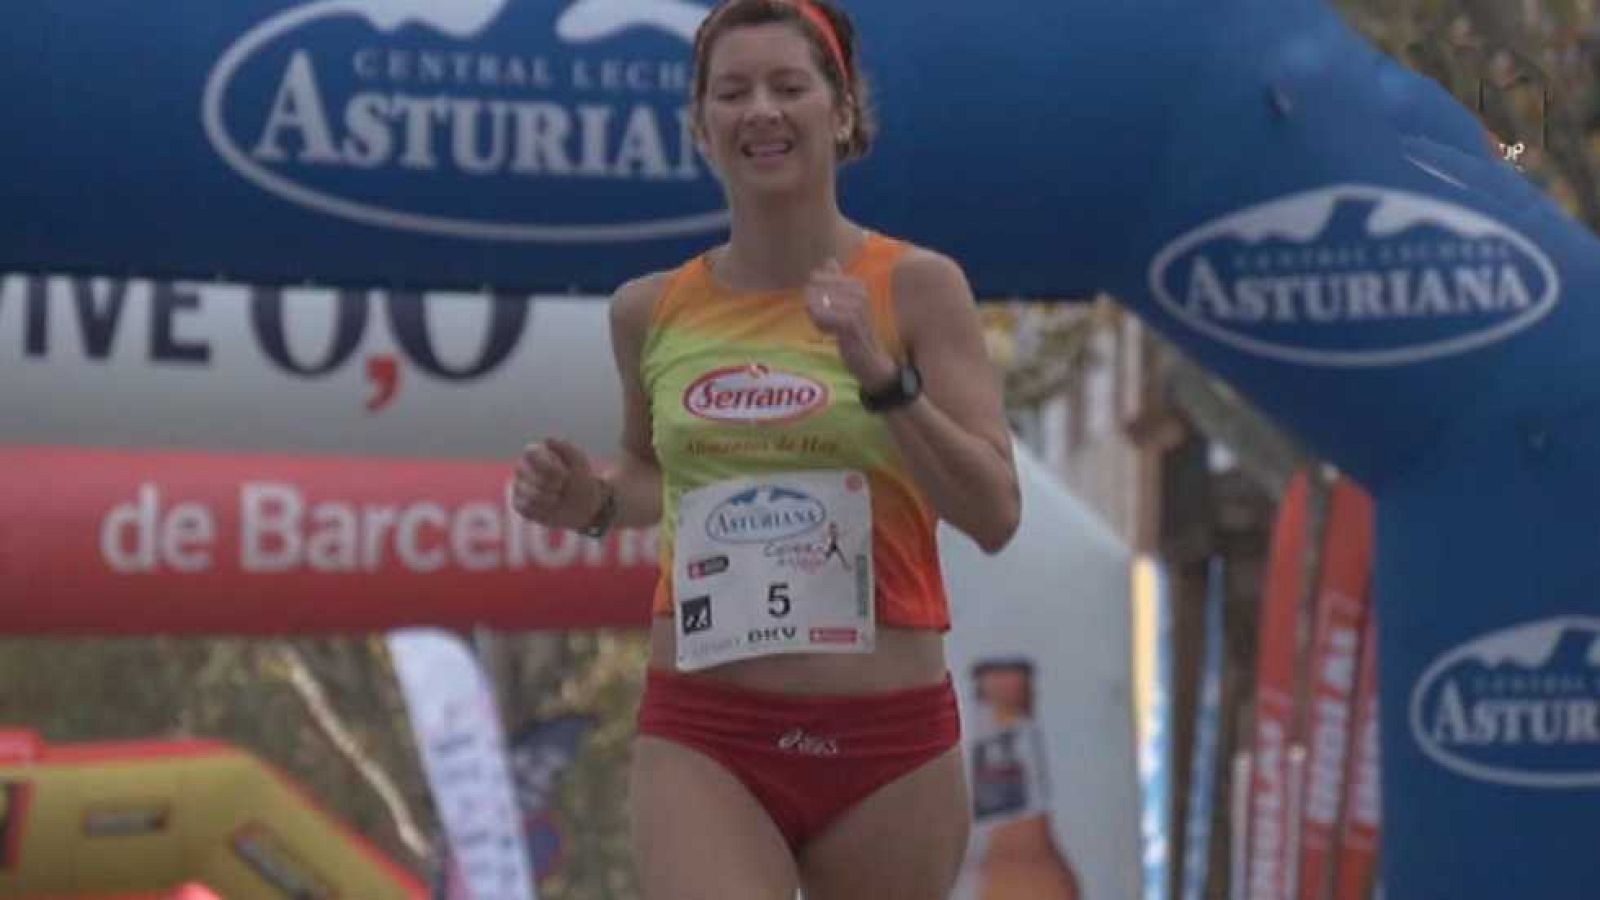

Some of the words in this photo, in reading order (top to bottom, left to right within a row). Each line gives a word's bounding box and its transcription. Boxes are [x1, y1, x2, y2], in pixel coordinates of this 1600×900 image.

[353, 49, 552, 86] CENTRAL
[571, 64, 686, 91] LECH
[1184, 256, 1530, 324] ASTURIANA
[0, 276, 211, 364] IVE
[696, 383, 817, 409] Serrano
[101, 482, 212, 573] de
[767, 582, 792, 618] 5
